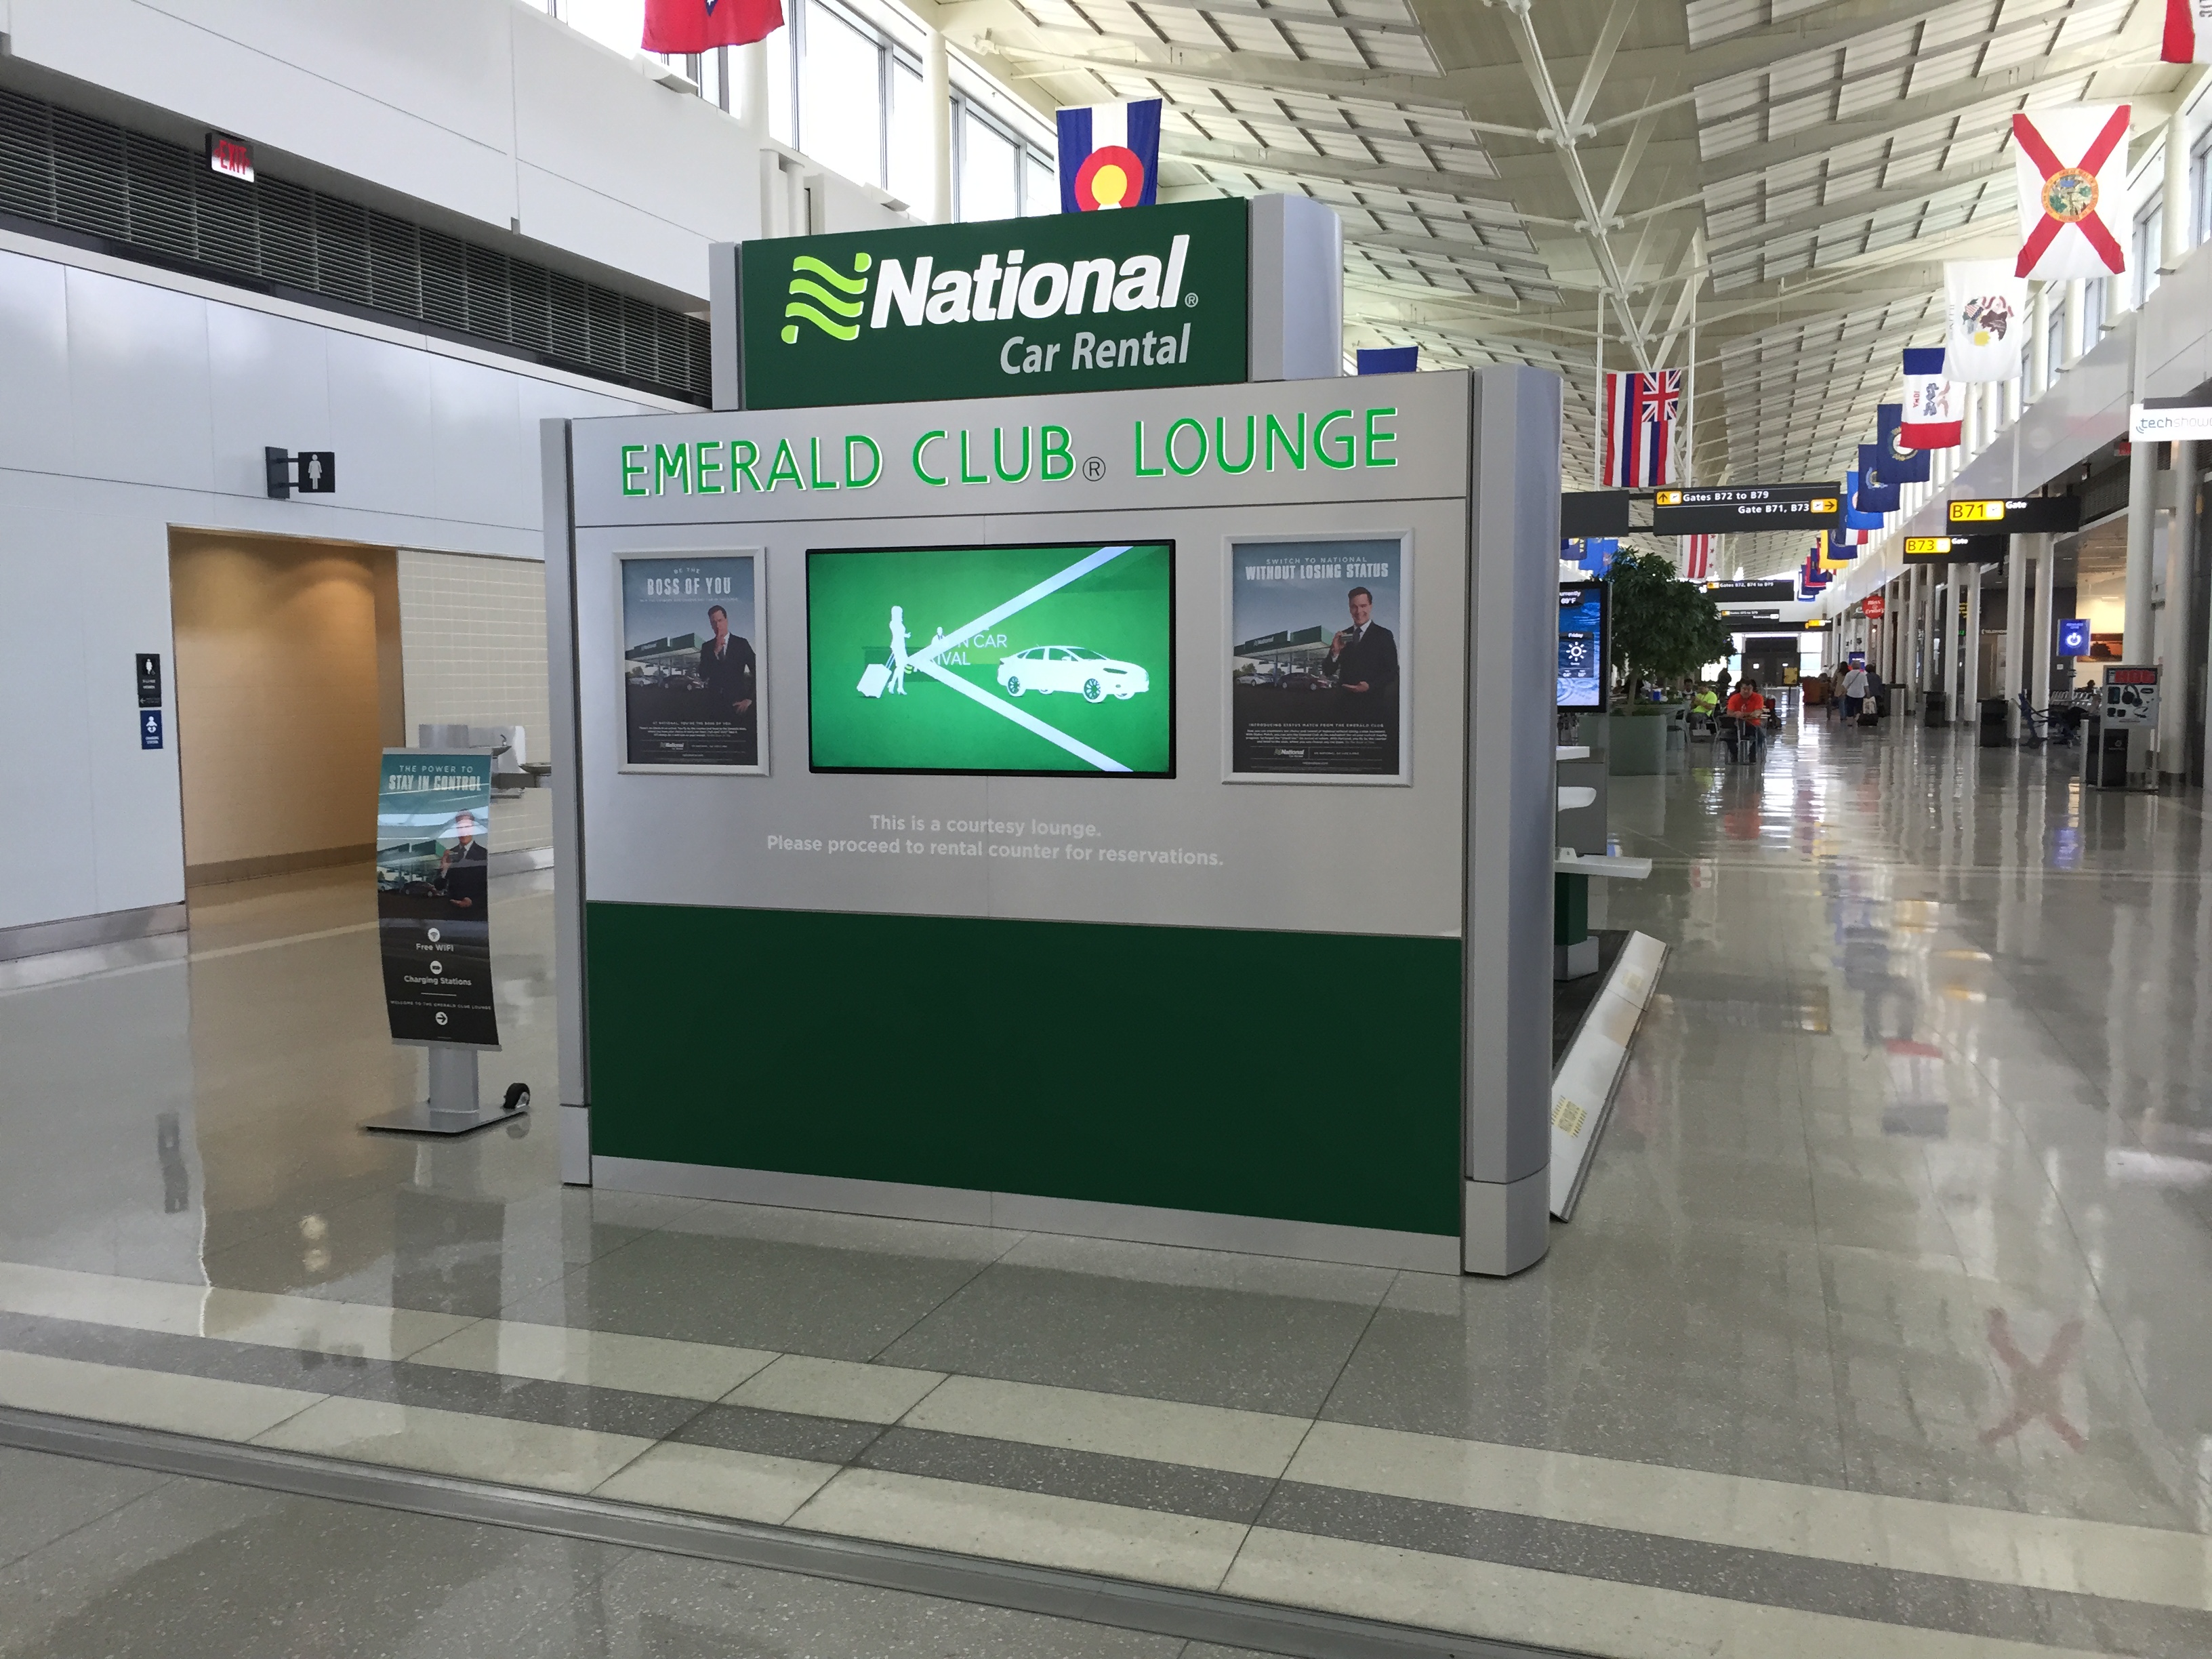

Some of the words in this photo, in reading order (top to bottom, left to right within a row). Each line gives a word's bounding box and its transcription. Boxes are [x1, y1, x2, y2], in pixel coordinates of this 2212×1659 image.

[219, 139, 247, 175] EXIT
[1000, 336, 1054, 375] Car
[1071, 322, 1191, 371] Rental
[1912, 390, 1921, 408] IOWA
[2140, 416, 2212, 428] techshow
[621, 433, 884, 497] EMERALD
[1135, 407, 1399, 477] LOUNGE
[1682, 493, 1711, 502] Gates
[1715, 492, 1733, 501] B72
[1736, 492, 1747, 500] to
[1750, 491, 1769, 499] B79
[1738, 505, 1762, 514] Gate
[1765, 504, 1788, 514] B71,
[1790, 504, 1809, 512] B73
[1952, 504, 1984, 518] B71
[2005, 500, 2028, 510] Gate
[1908, 539, 1935, 551] B73
[1320, 556, 1368, 564] NATIONAL
[1245, 565, 1296, 581] WITHOUT
[1300, 564, 1342, 579] LOSING
[1346, 562, 1389, 578] STATUS
[647, 577, 680, 596] BOSS
[684, 577, 700, 595] OF
[705, 577, 732, 594] YOU
[973, 634, 1008, 648] CAR
[935, 651, 971, 665] IVAL
[422, 765, 456, 773] POWER
[462, 765, 474, 773] TO
[388, 774, 414, 791] STAY
[417, 775, 430, 791] IN
[434, 775, 482, 792] CONTROL
[869, 815, 905, 831] This
[912, 815, 925, 832] is
[930, 819, 941, 832] a
[947, 818, 1025, 837] courtesy
[1031, 819, 1101, 839] lounge.
[767, 835, 823, 851] Please
[828, 838, 900, 854] proceed
[906, 839, 924, 855] to
[930, 840, 983, 857] rental
[988, 844, 1060, 859] counter
[1065, 844, 1092, 860] for
[1098, 848, 1224, 865] reservations.
[415, 943, 434, 951] Free
[404, 975, 438, 985] Charging
[440, 977, 472, 986] Stations
